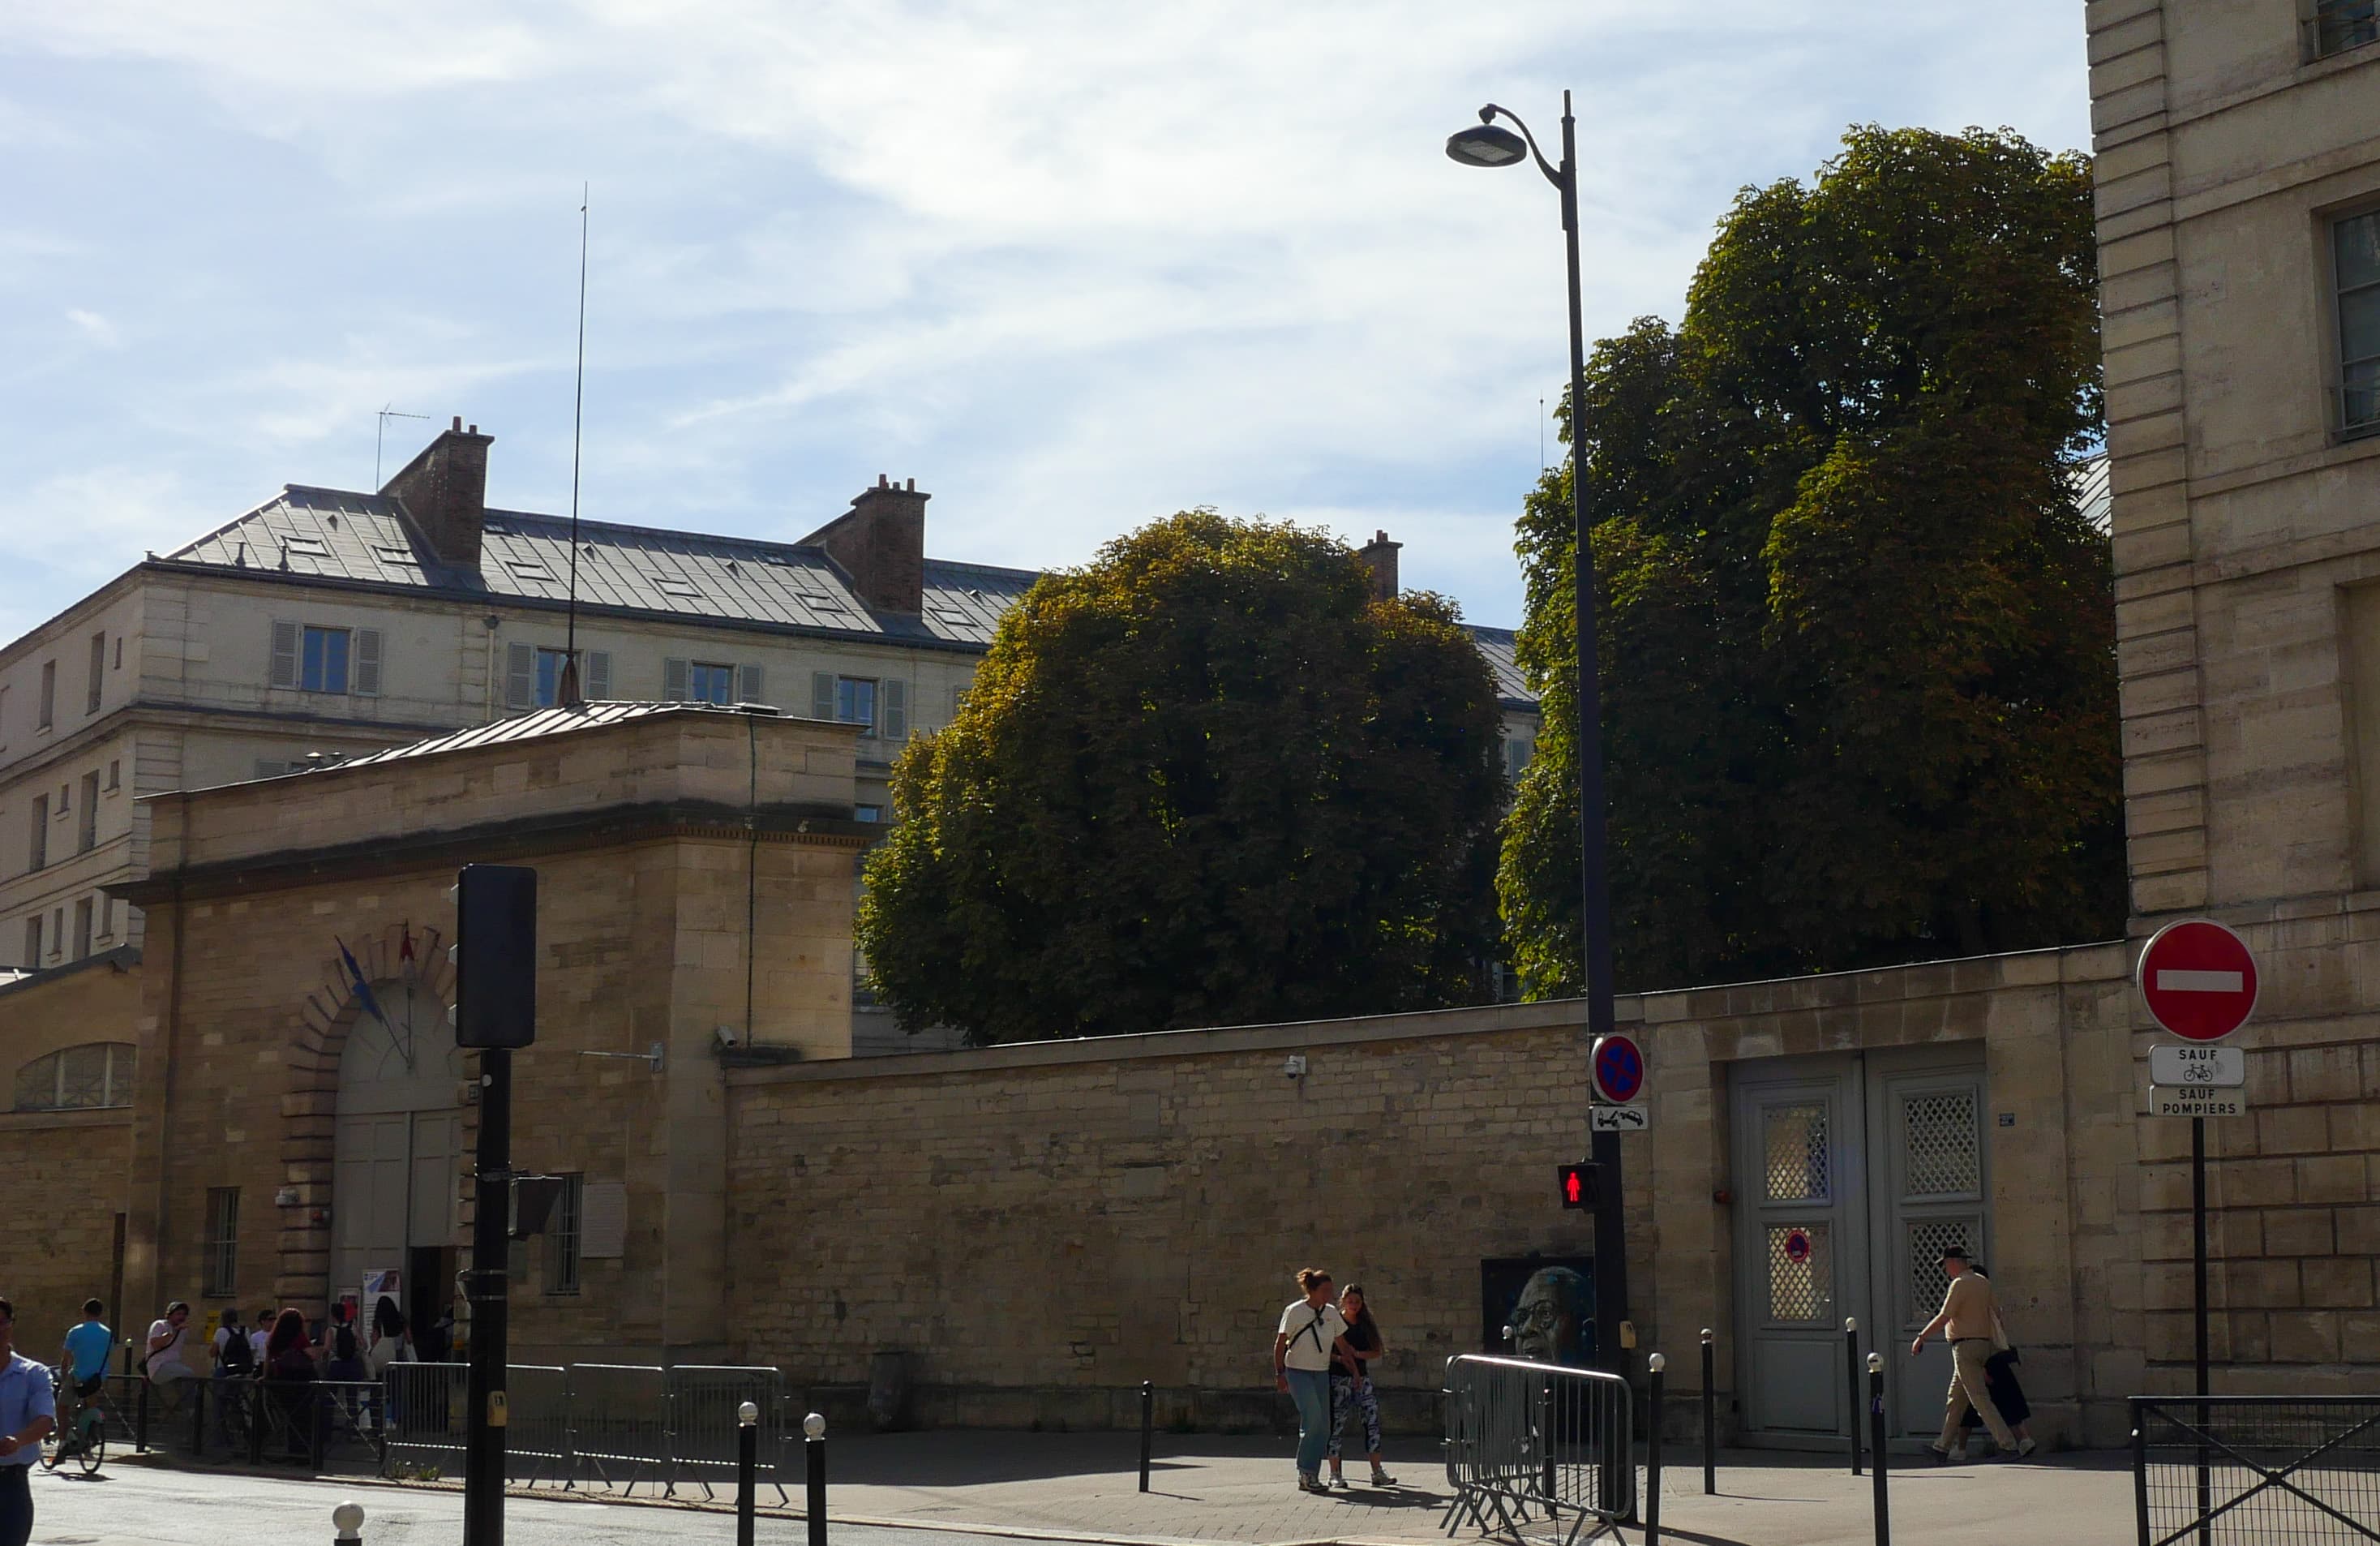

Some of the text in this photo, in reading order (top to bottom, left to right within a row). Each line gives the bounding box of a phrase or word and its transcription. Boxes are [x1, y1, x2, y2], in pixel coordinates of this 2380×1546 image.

[2179, 1050, 2217, 1060] SAUF
[2180, 1089, 2215, 1100] SAUF
[2163, 1103, 2236, 1114] POMPIERS
